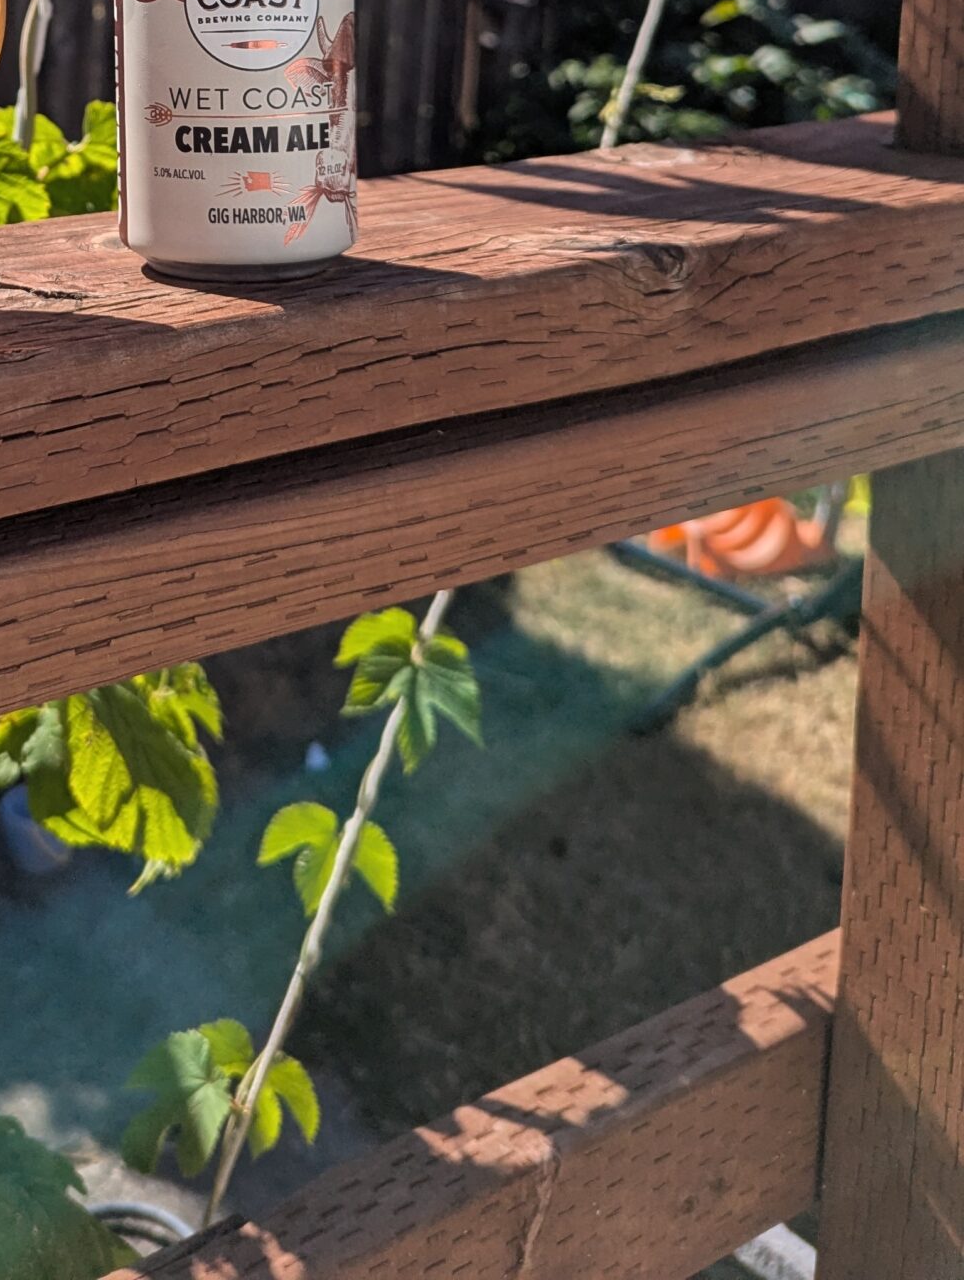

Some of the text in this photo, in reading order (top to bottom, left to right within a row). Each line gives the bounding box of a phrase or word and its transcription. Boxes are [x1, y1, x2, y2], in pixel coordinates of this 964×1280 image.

[197, 14, 309, 25] BREWING COMPANY
[169, 83, 333, 110] WET COAST
[175, 122, 330, 154] CREAM ALE
[153, 166, 172, 178] 5.0%
[208, 205, 306, 225] GIG HARBOR, WA
